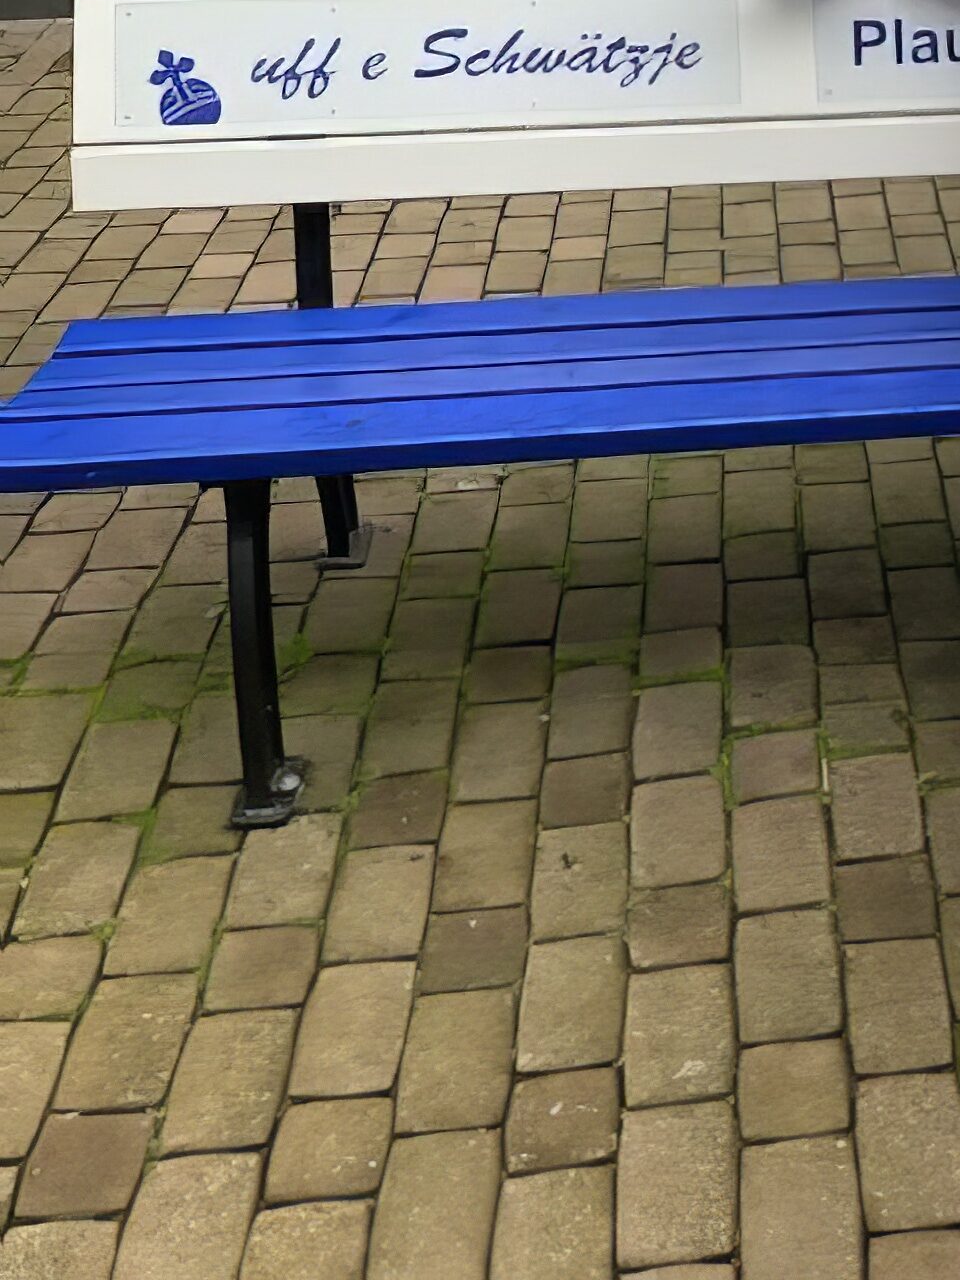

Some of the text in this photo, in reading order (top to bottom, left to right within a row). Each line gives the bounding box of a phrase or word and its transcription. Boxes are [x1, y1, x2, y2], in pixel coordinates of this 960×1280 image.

[251, 28, 703, 100] uff e Schwätzje
